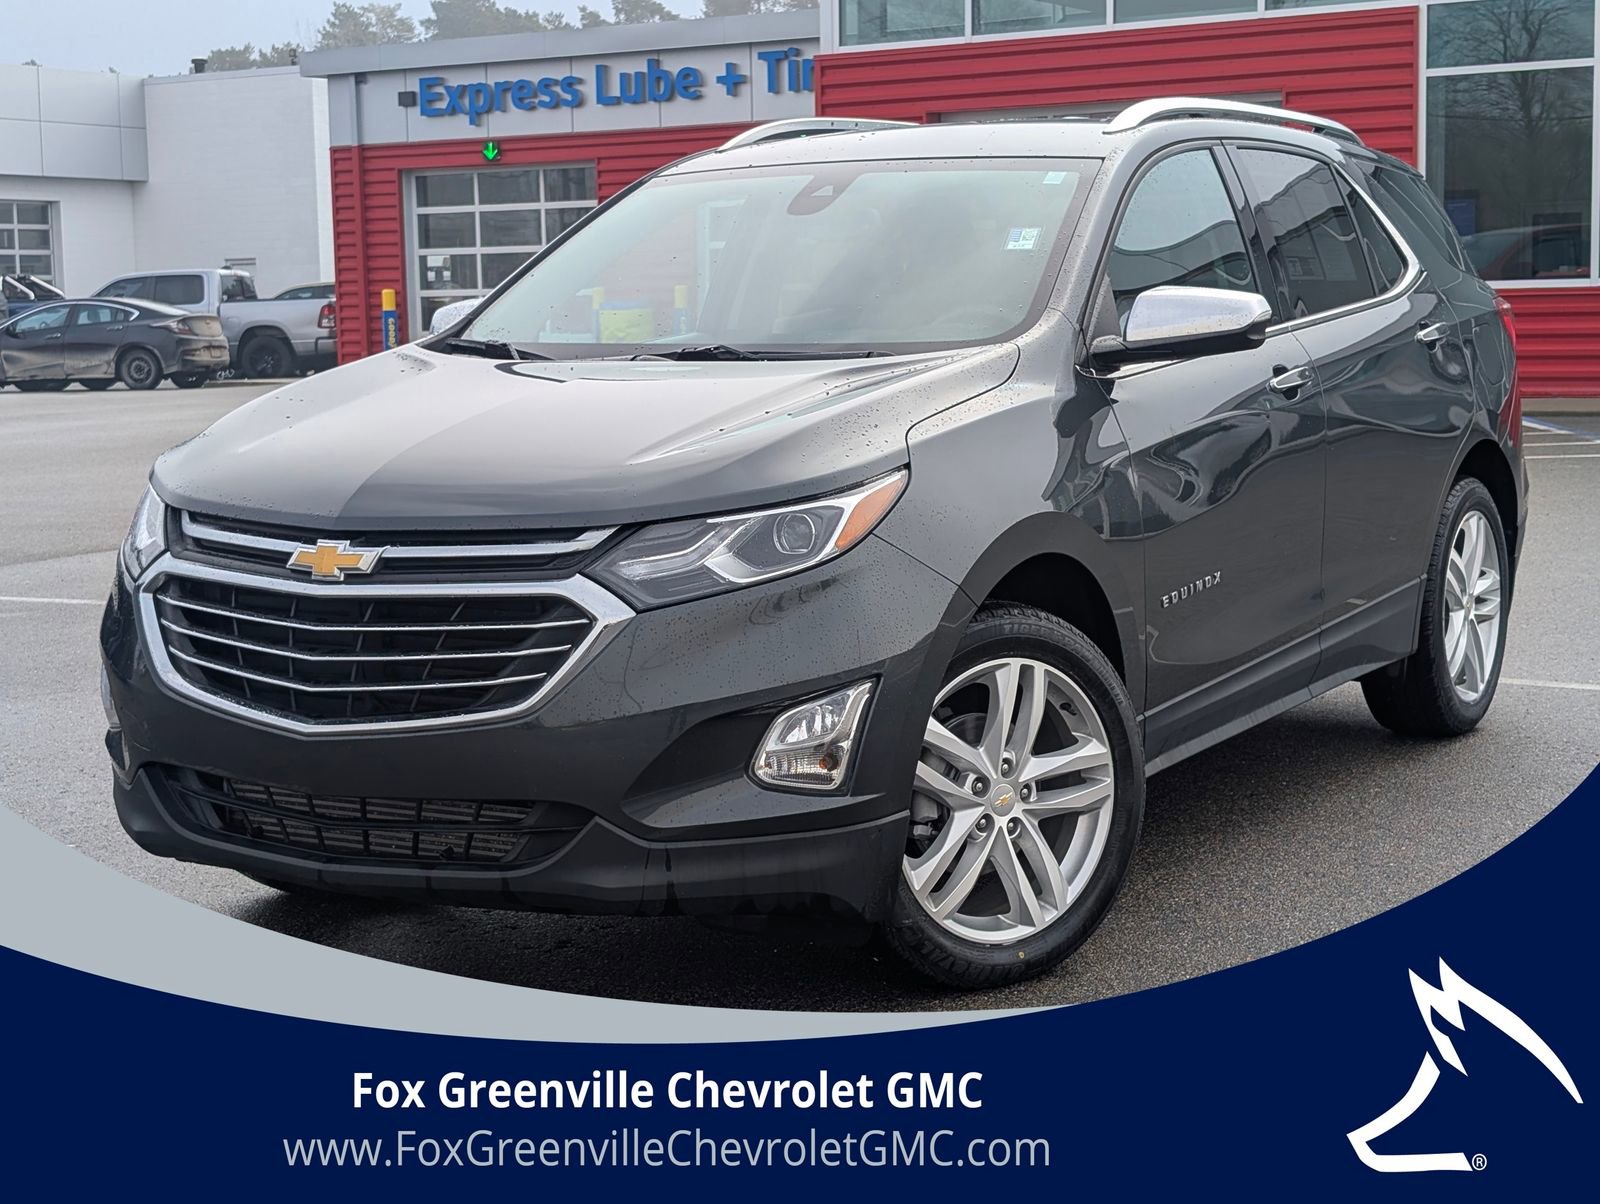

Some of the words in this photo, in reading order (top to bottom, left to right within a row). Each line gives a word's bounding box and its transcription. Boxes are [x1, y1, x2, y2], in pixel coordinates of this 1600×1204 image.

[418, 75, 583, 126] Express
[595, 59, 702, 106] Lube
[1162, 570, 1221, 608] EQUINOX
